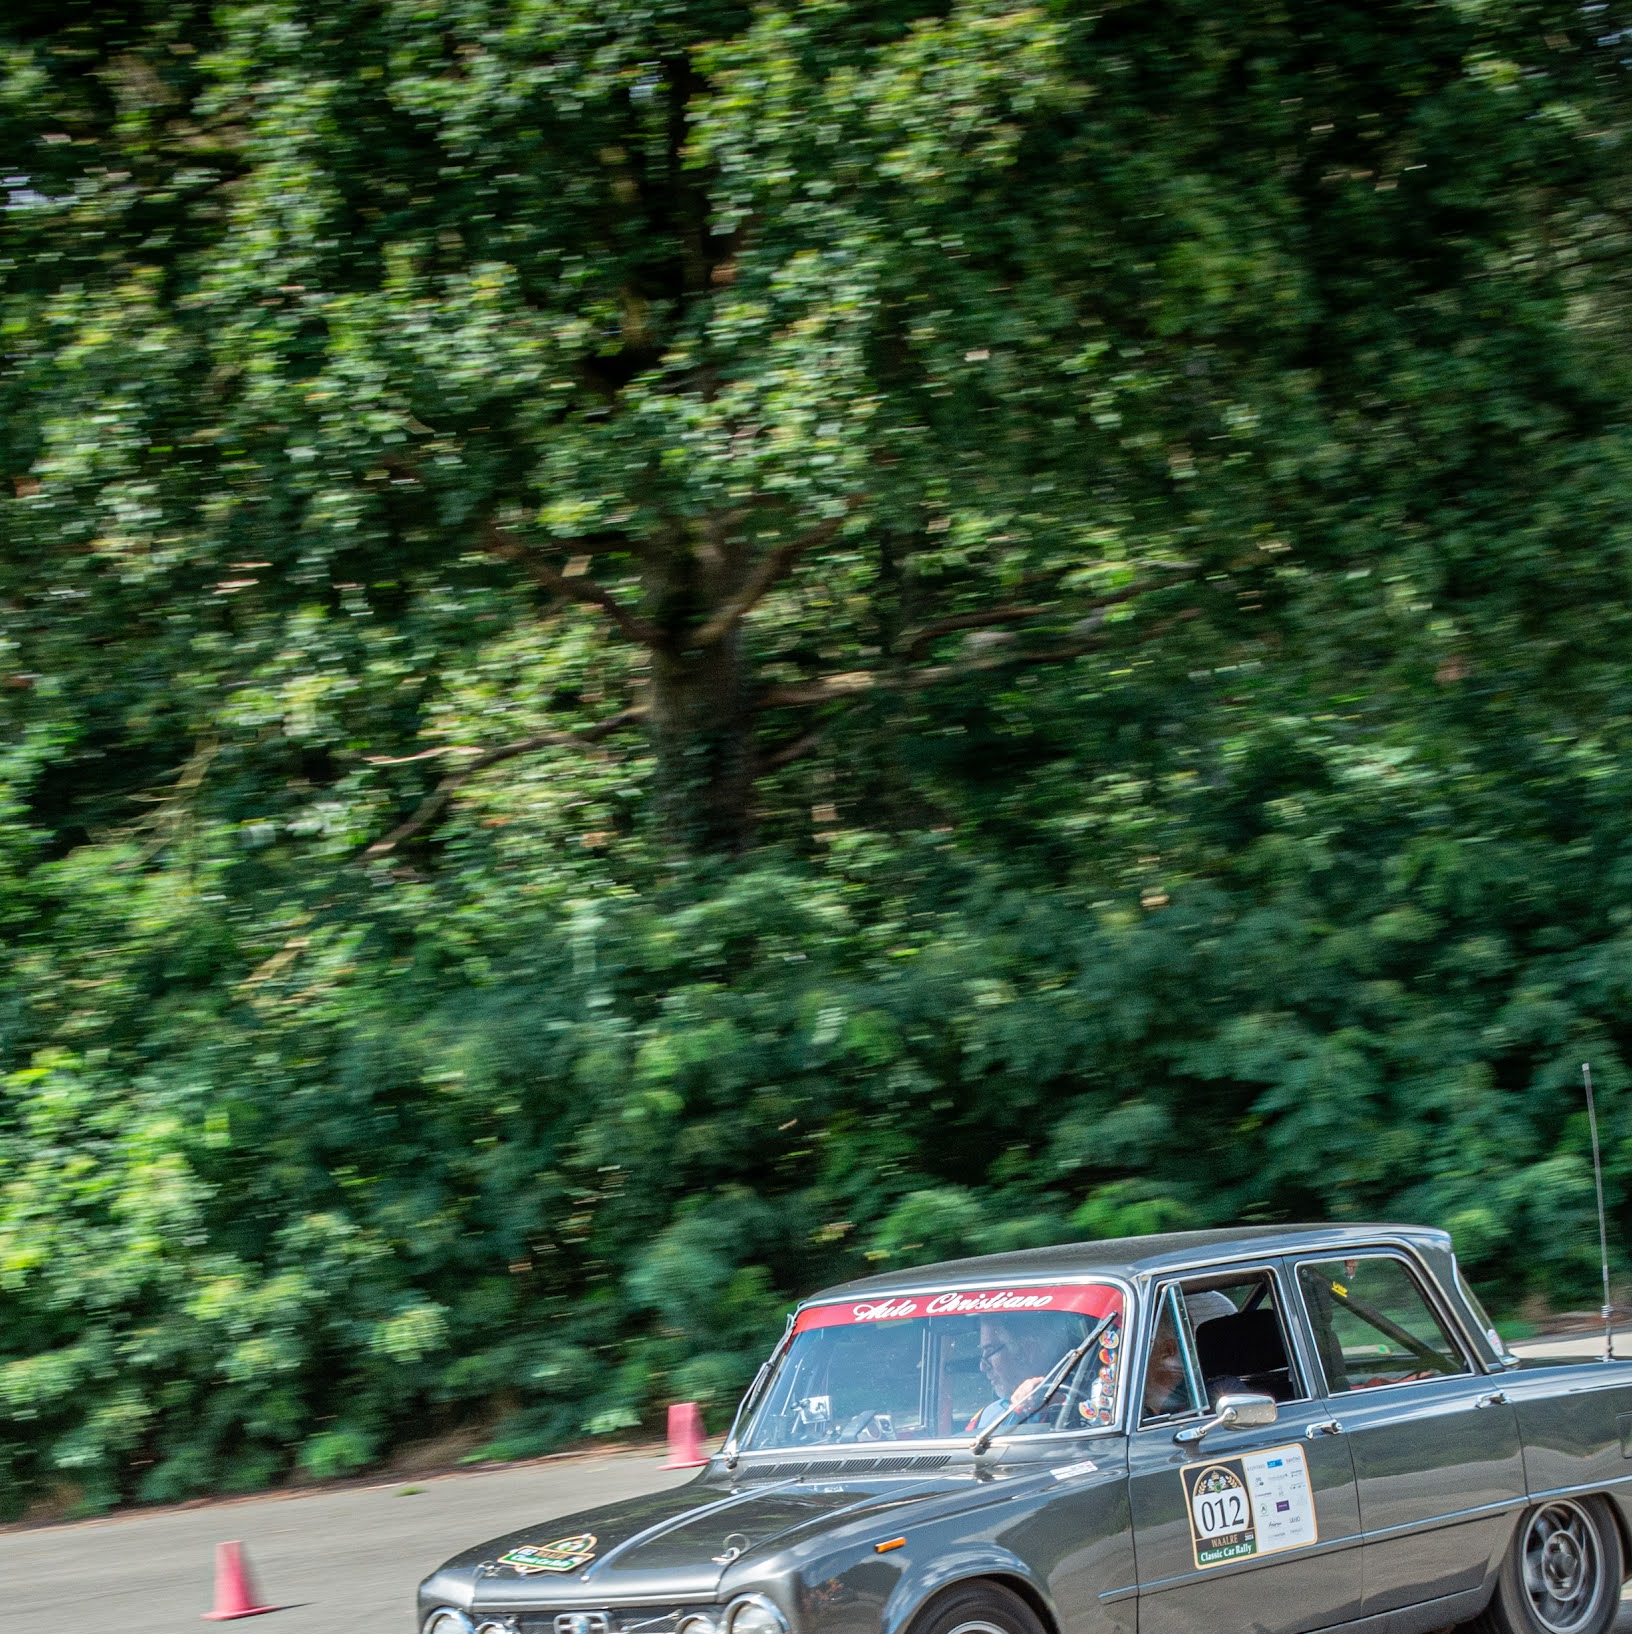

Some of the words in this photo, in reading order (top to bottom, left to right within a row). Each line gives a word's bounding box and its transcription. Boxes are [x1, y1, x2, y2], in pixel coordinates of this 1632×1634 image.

[853, 1298, 918, 1321] Auto
[926, 1292, 1053, 1314] Christiano
[1201, 1495, 1245, 1532] 012
[1200, 1549, 1223, 1562] Classic
[1223, 1547, 1235, 1557] Car
[1235, 1543, 1252, 1555] Rally
[1211, 1533, 1239, 1548] WAALRE
